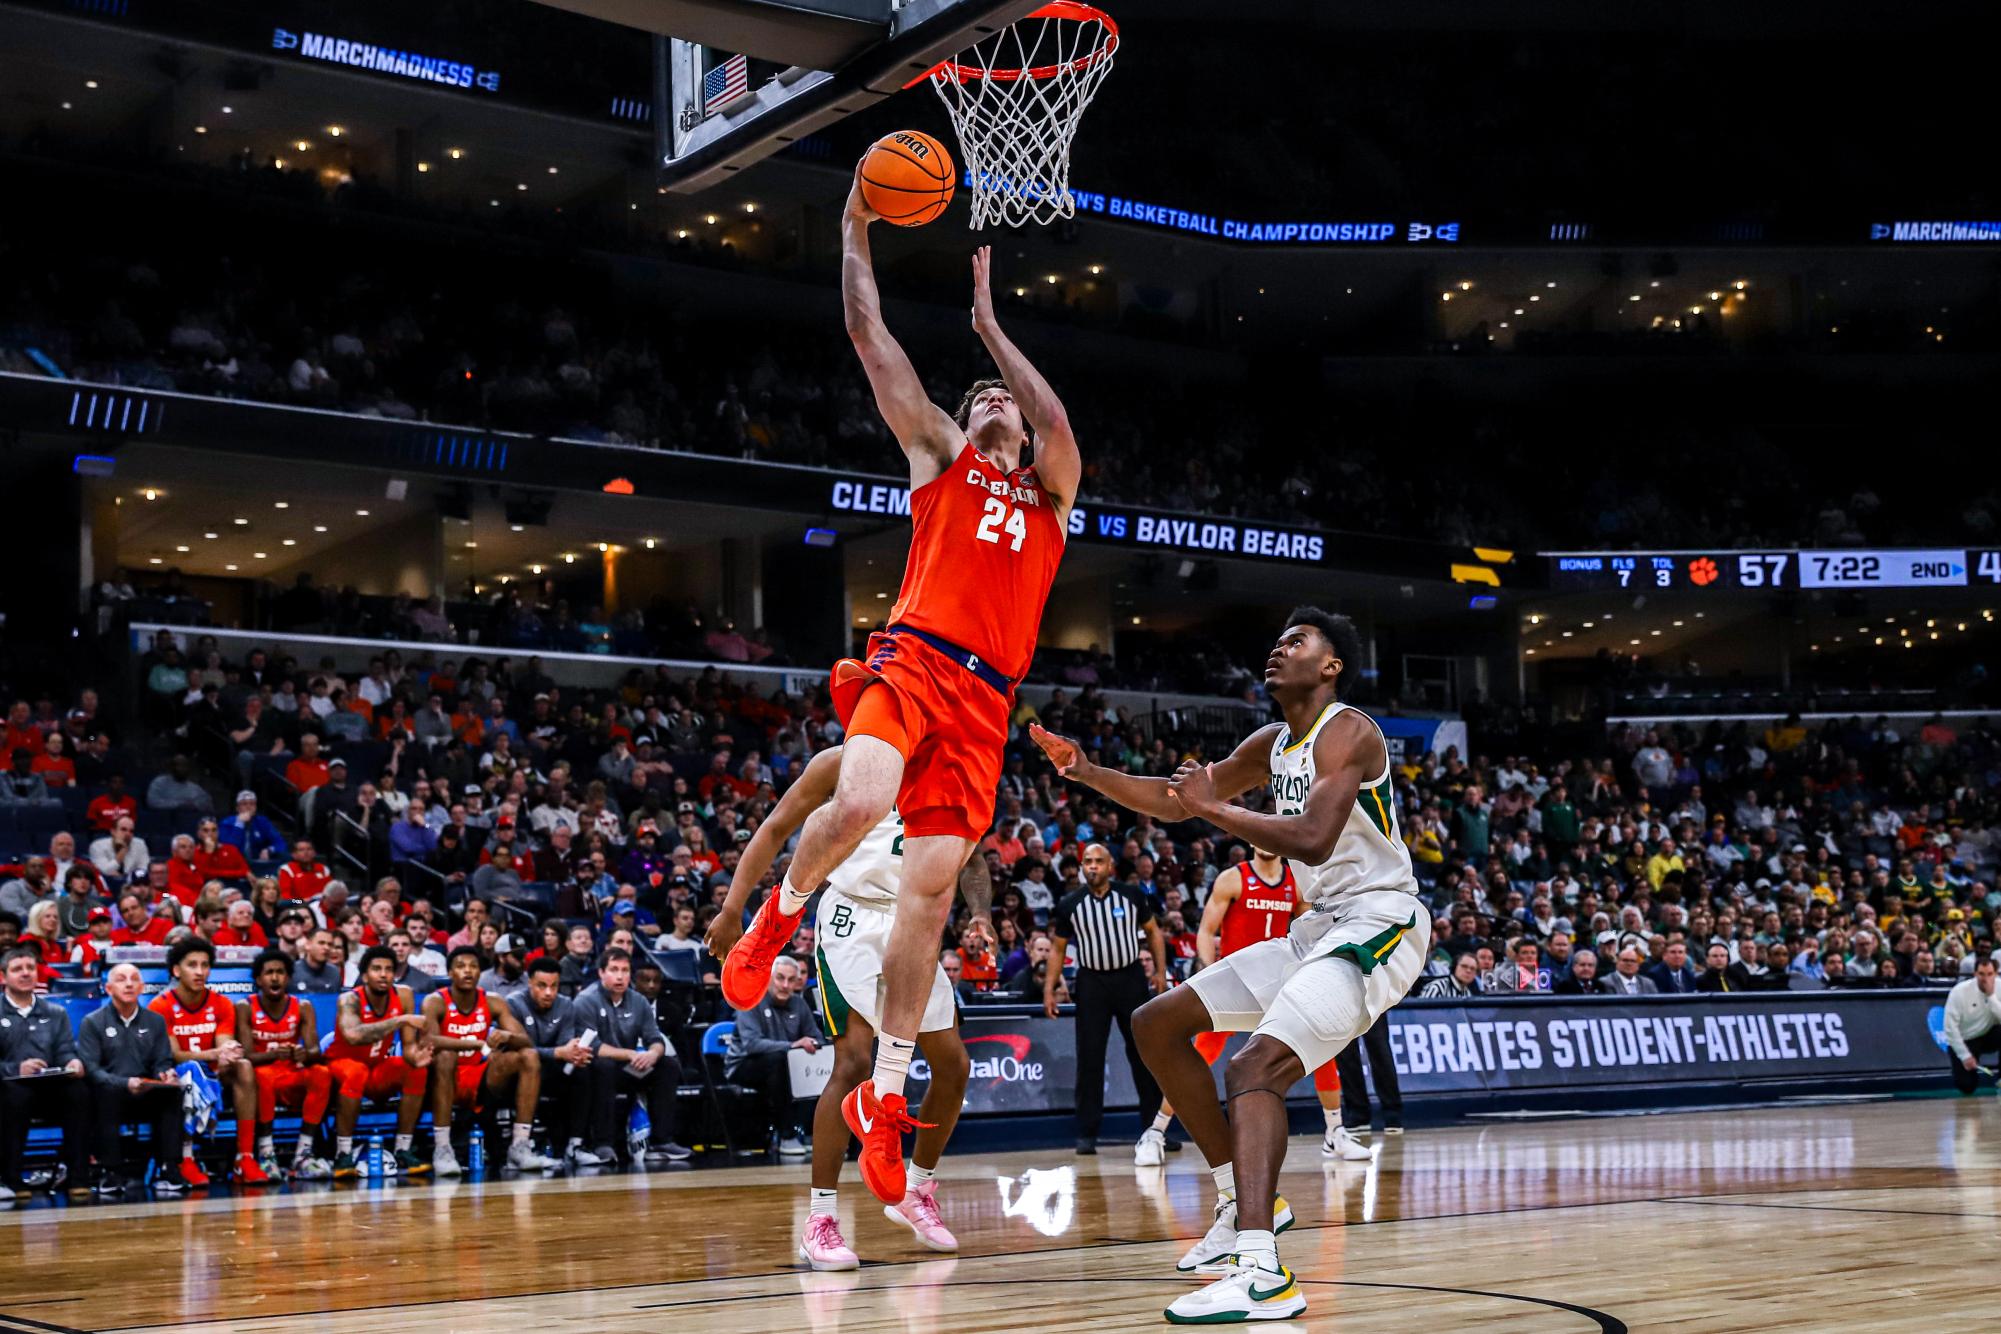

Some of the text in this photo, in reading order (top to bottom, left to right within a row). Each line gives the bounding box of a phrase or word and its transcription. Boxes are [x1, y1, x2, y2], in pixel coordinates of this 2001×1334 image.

[301, 32, 475, 88] MARCHMADNESS
[1110, 198, 1219, 235] BASKETBALL
[1223, 220, 1395, 241] CHAMPIONSHIP
[976, 496, 1027, 553] 24
[1099, 515, 1127, 538] VS
[1137, 516, 1236, 552] BAYLOR
[1243, 528, 1324, 561] BEARS
[1560, 558, 1602, 571] BONUS
[1612, 558, 1635, 571] FLS
[1617, 570, 1671, 587] 7 3
[1739, 555, 1788, 587] 57
[1813, 556, 1950, 582] 7:22 2ND
[966, 654, 979, 671] C
[1246, 898, 1294, 912] CLEMSON
[829, 904, 856, 938] BU
[1264, 913, 1273, 938] 1
[188, 1036, 201, 1053] 5
[1548, 1013, 1850, 1069] STUDENT-ATHLETES
